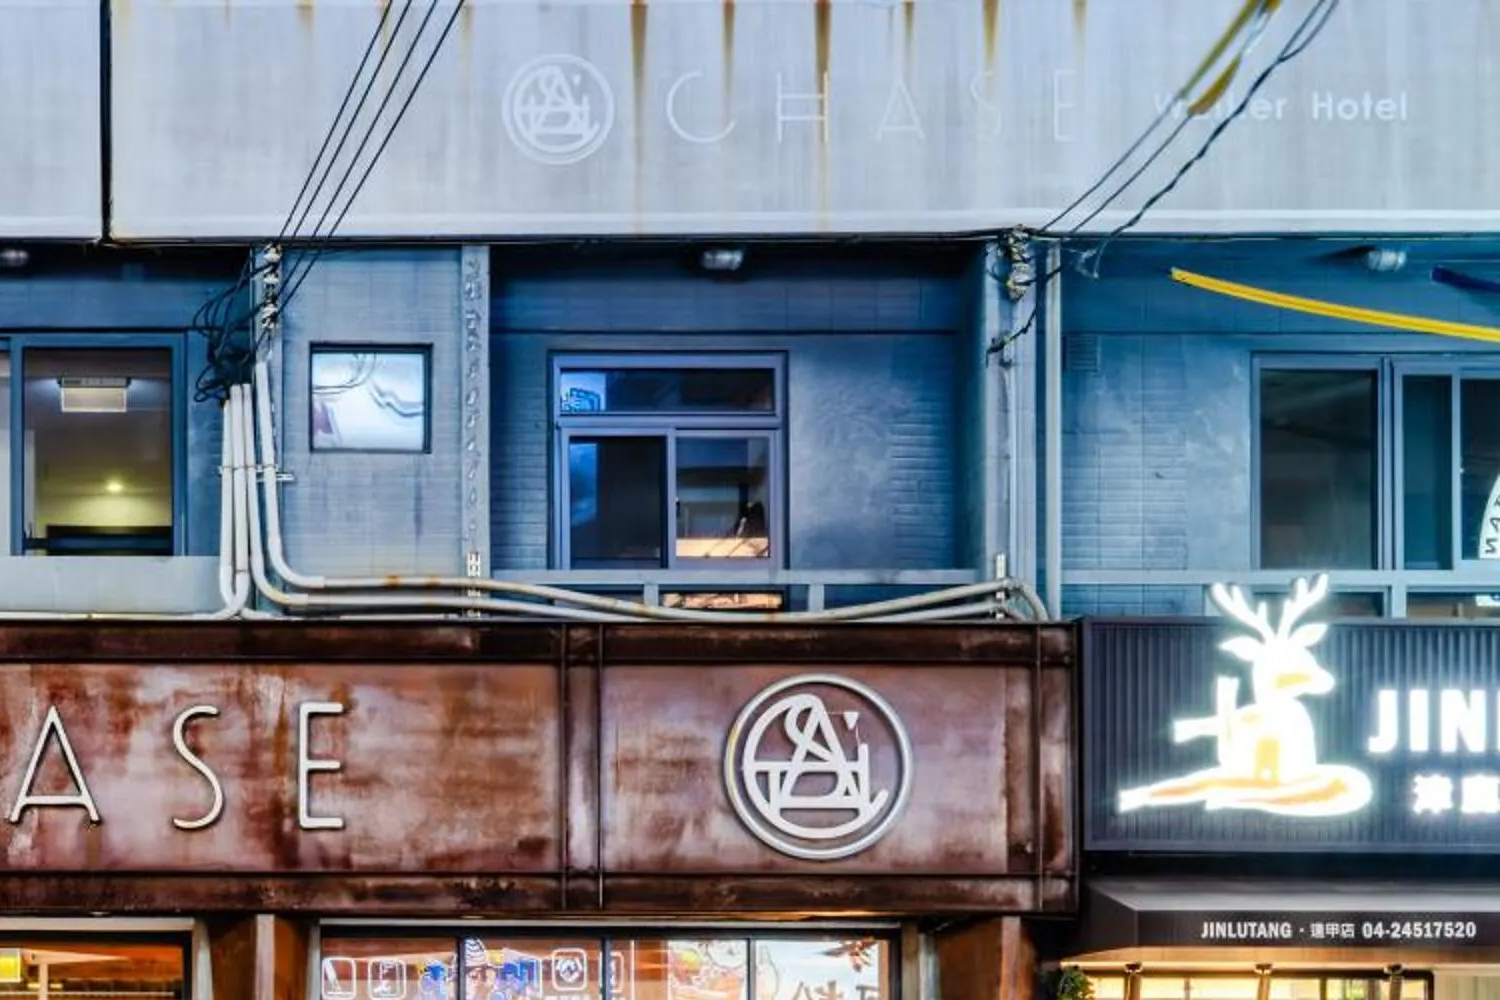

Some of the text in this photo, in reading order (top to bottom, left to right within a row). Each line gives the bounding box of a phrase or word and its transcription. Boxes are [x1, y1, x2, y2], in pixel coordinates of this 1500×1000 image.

[665, 69, 1077, 145] CHASE
[1311, 90, 1408, 121] Hotel
[1367, 688, 1500, 753] JIN
[1201, 921, 1292, 939] JINLUTANG
[1362, 921, 1477, 938] 04-24517520
